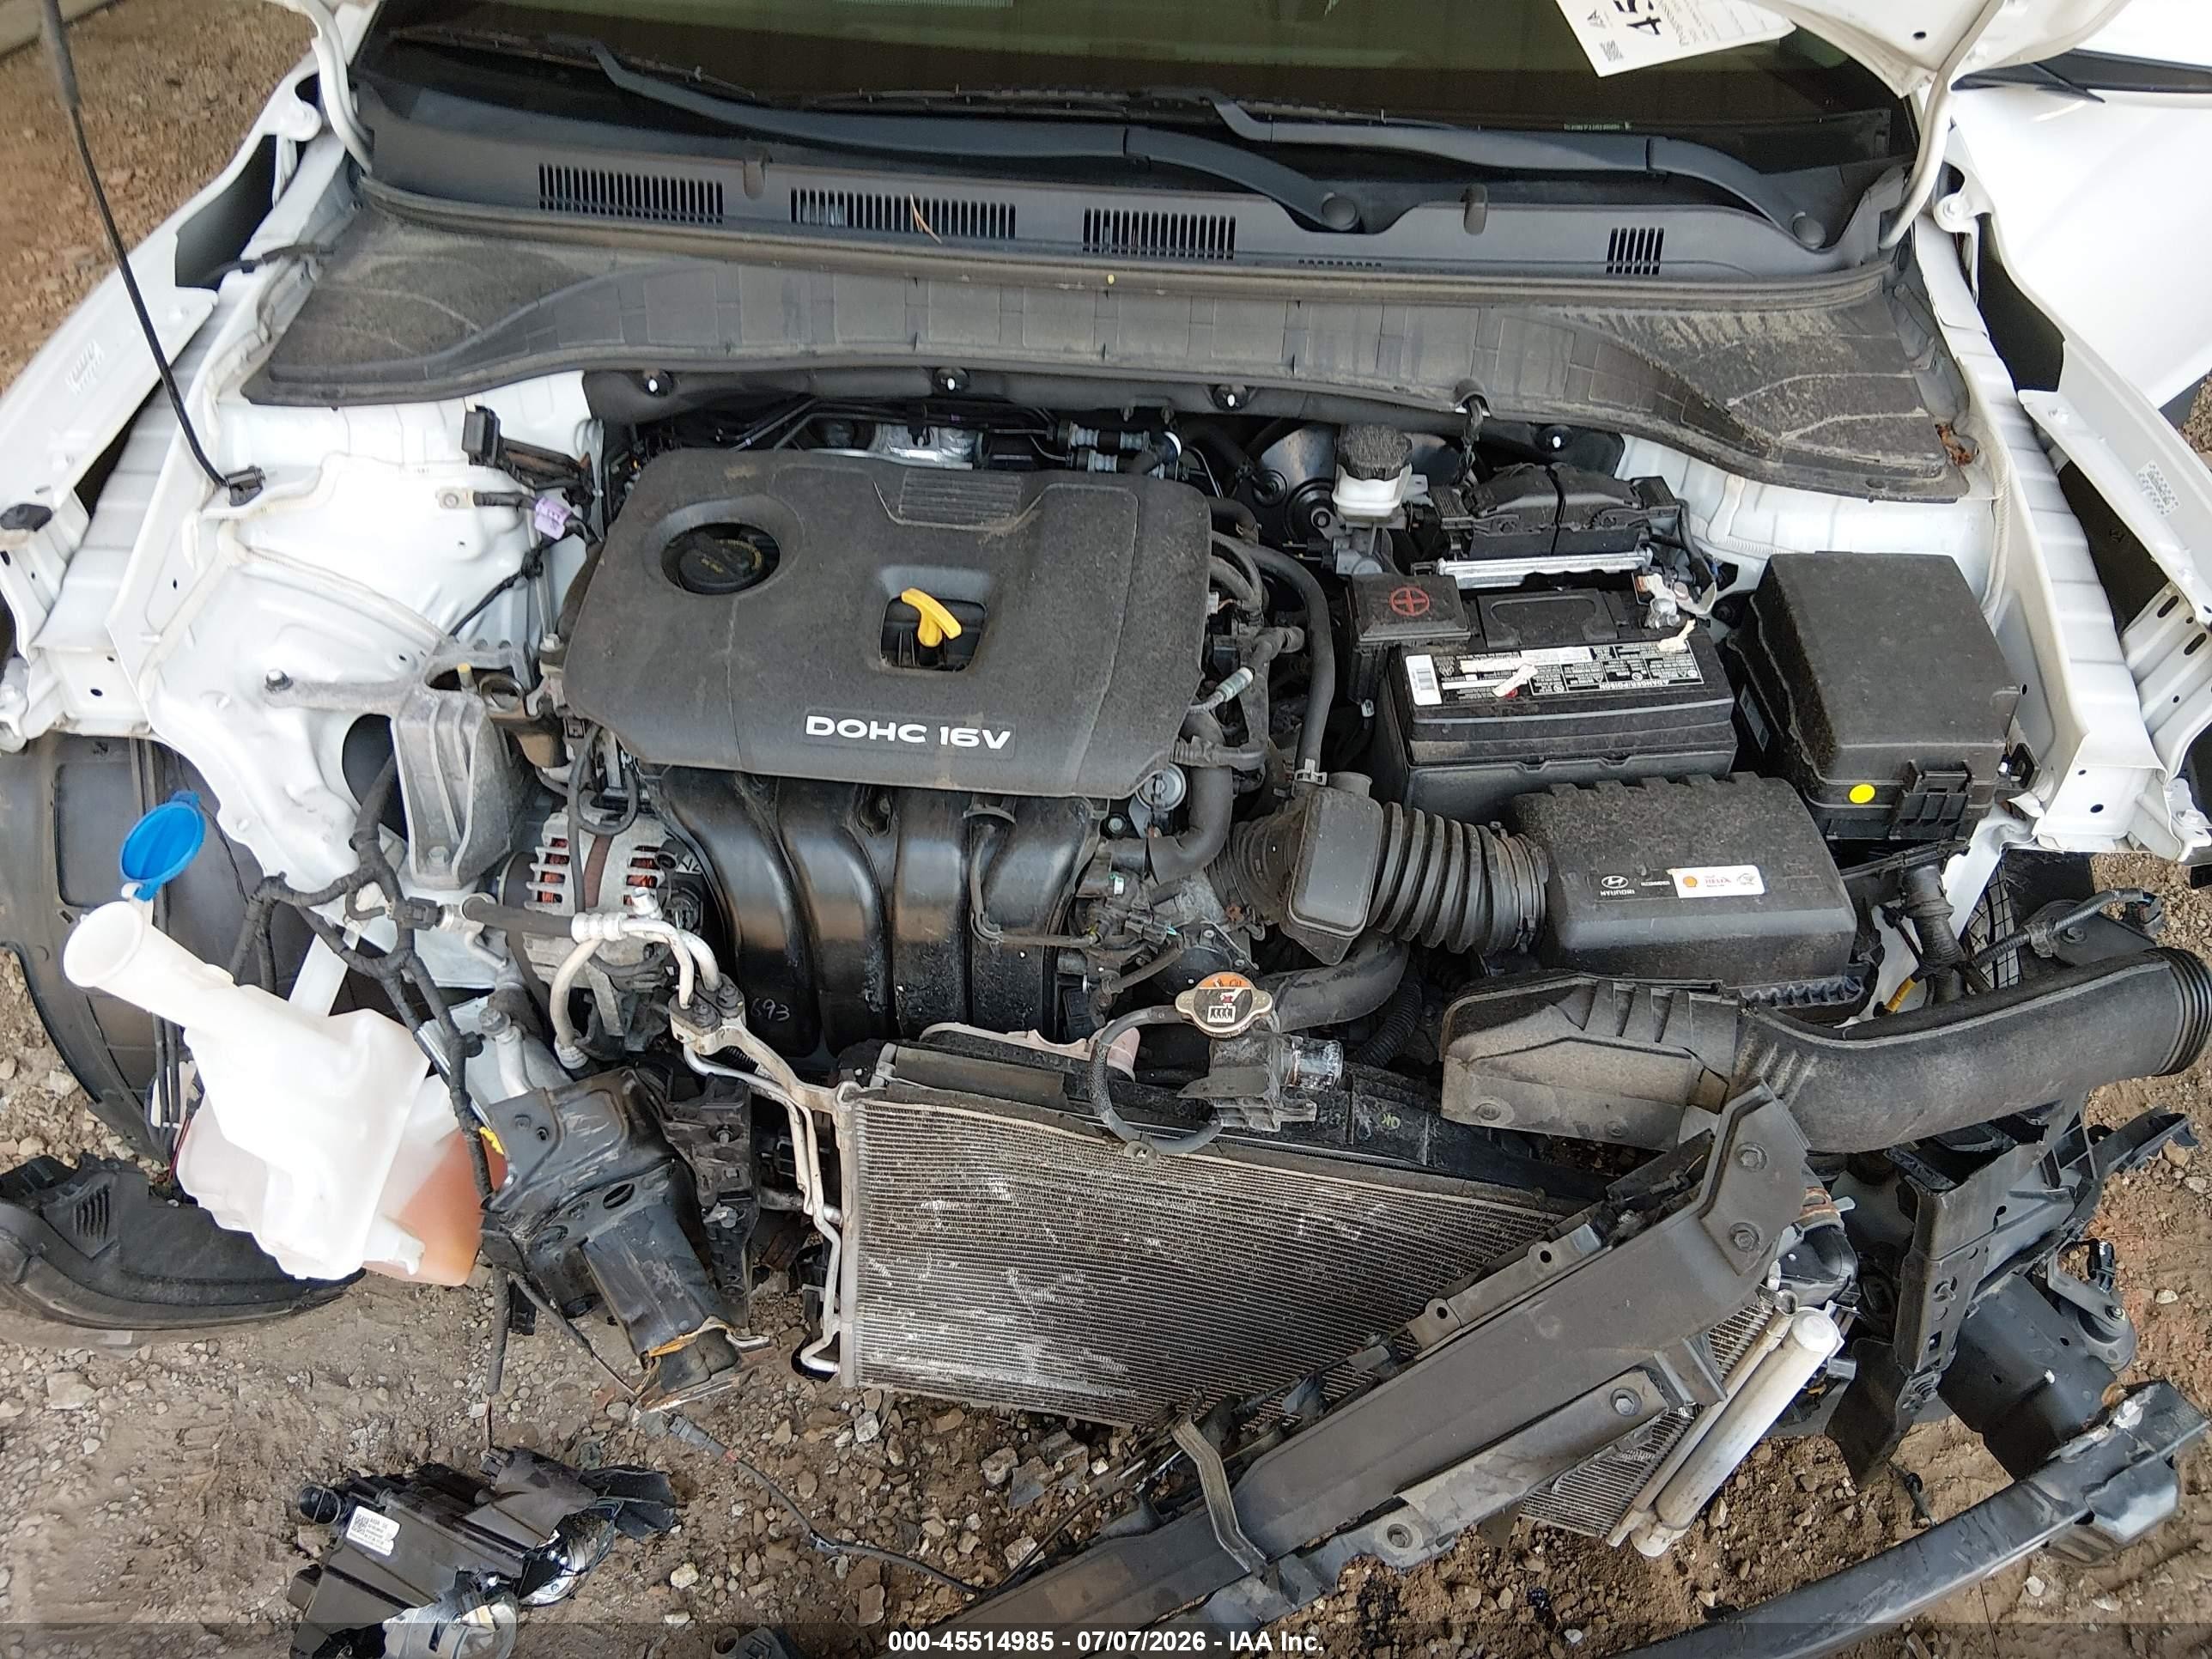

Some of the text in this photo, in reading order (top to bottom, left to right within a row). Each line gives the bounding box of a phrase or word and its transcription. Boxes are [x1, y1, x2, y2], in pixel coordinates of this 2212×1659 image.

[805, 715, 1011, 750] DOHC 16V
[750, 998, 791, 1022] 693
